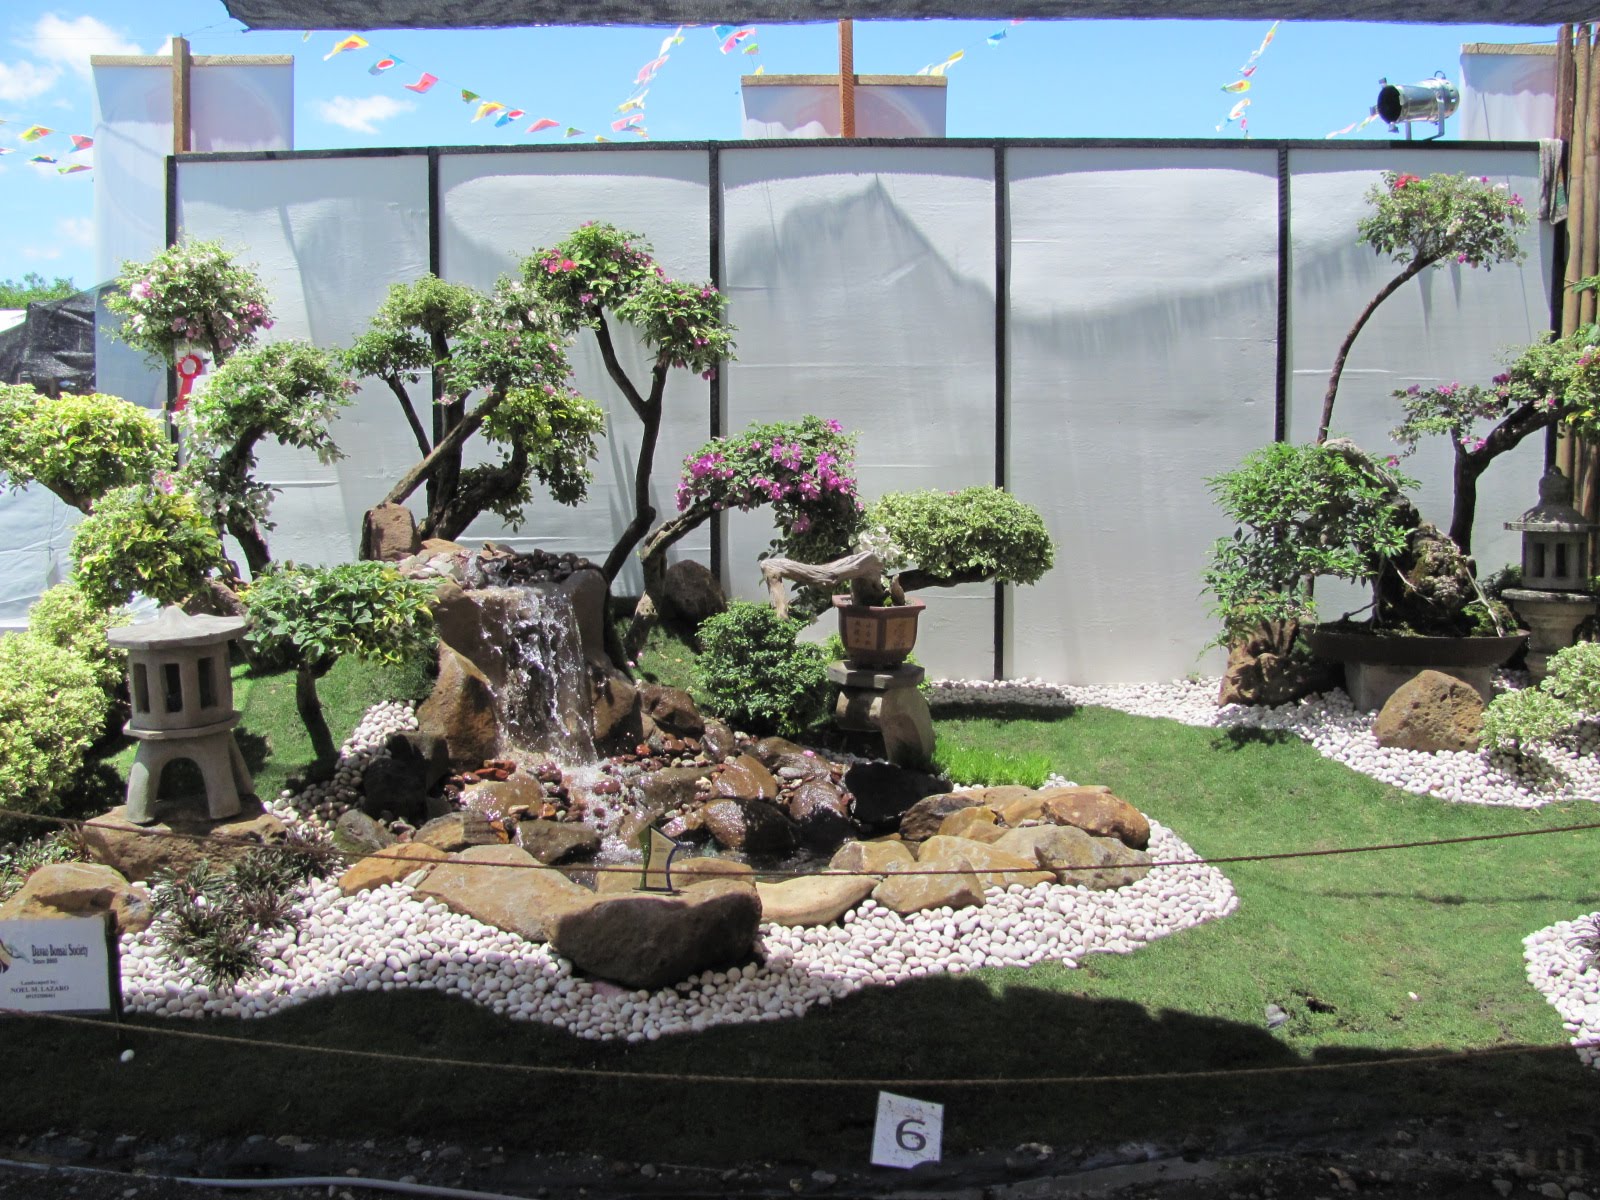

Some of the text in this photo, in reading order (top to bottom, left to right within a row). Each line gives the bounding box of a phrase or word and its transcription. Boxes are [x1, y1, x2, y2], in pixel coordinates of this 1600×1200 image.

[32, 944, 88, 957] Davao Bonsai Society
[40, 985, 69, 993] LAZARO
[896, 1118, 927, 1152] 6
